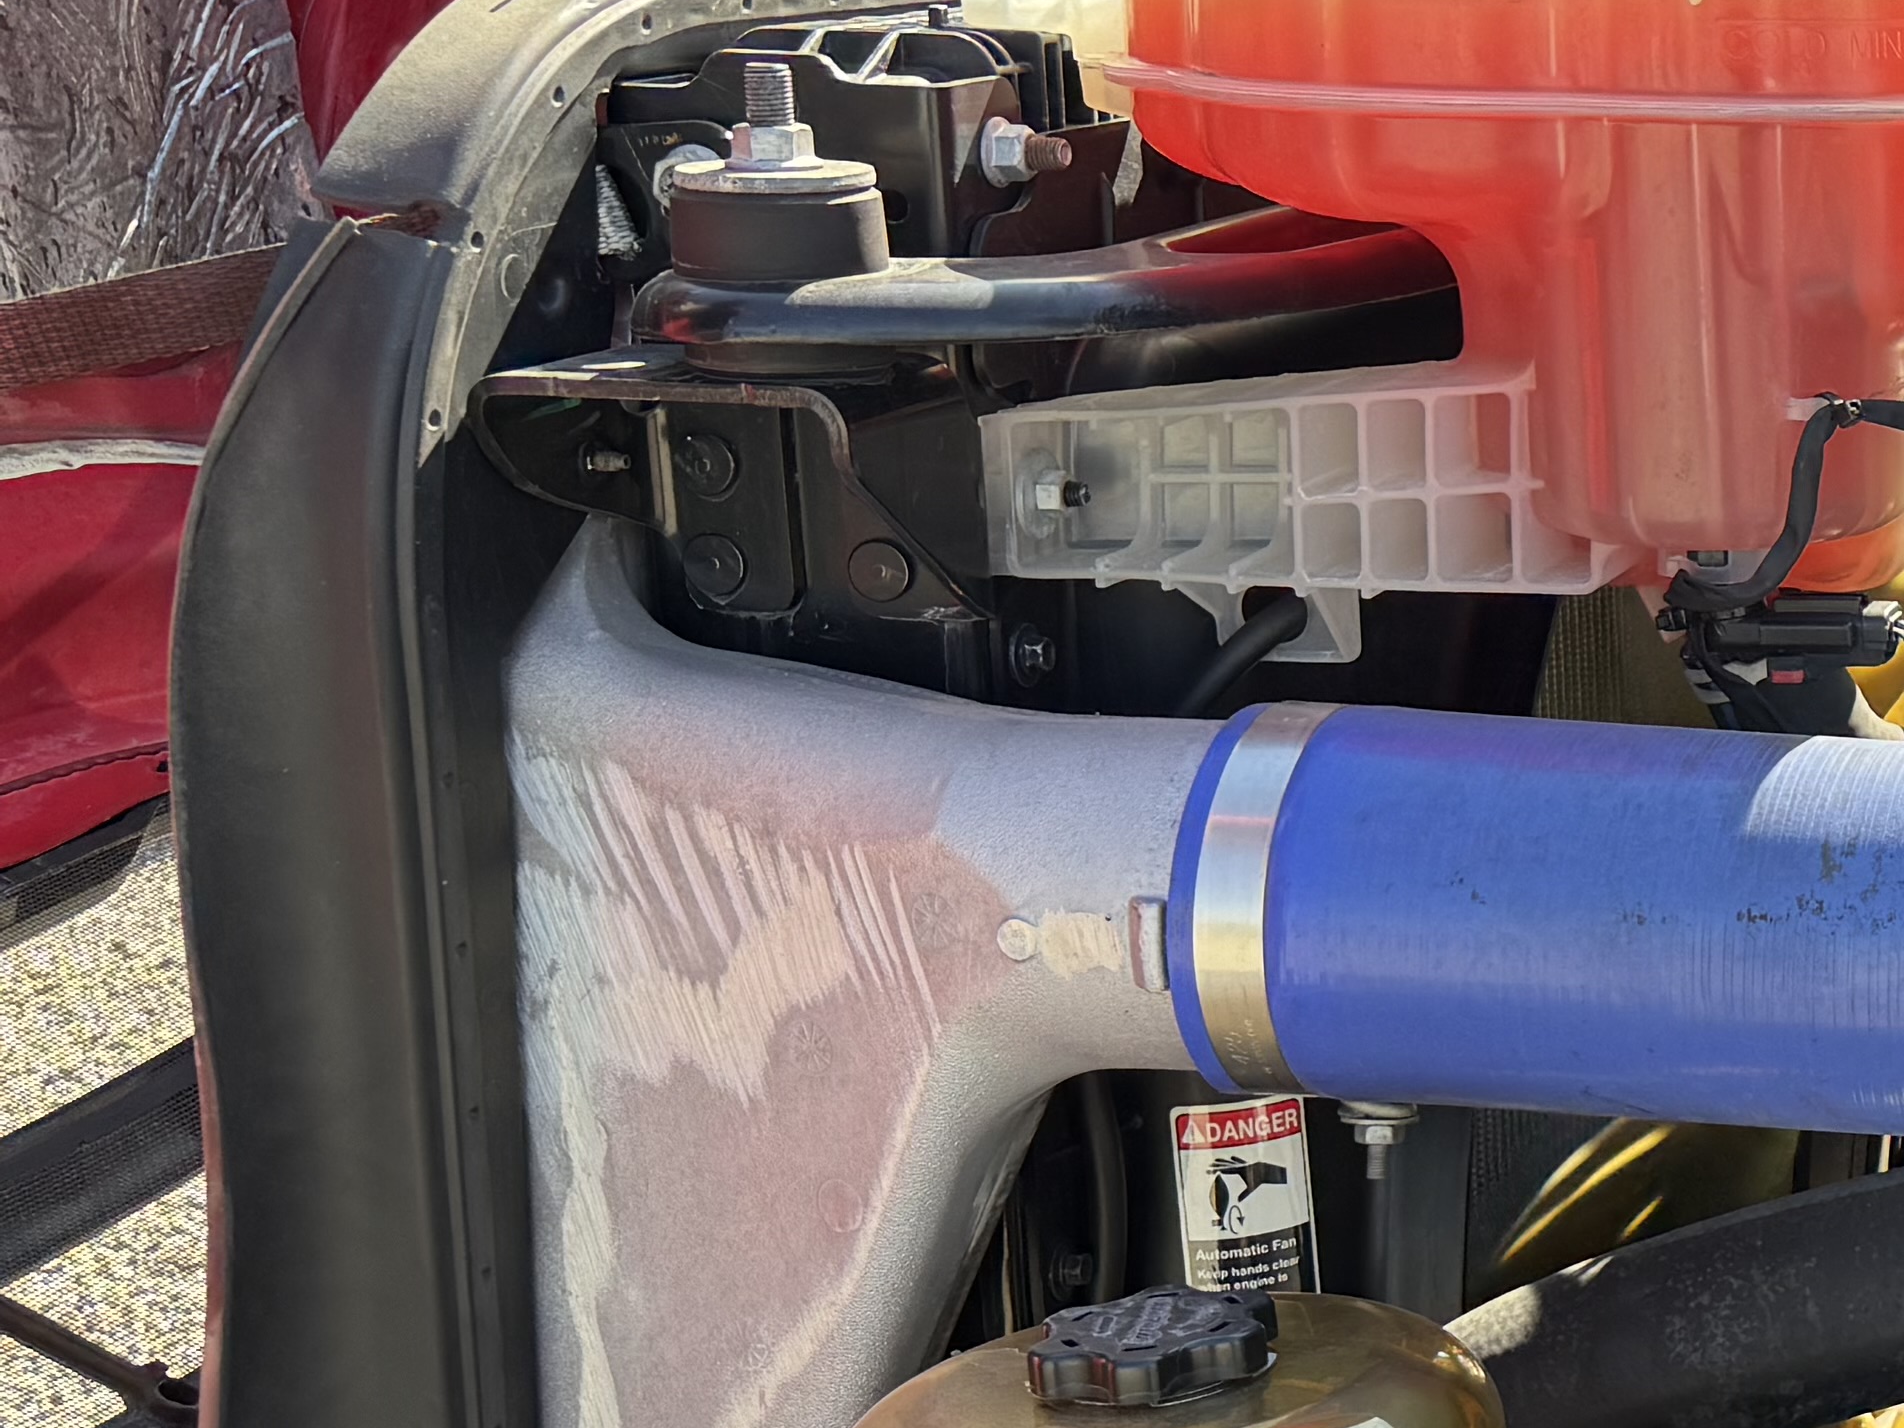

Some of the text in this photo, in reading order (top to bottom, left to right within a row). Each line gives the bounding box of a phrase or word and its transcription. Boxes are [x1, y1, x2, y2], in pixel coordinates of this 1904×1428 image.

[1206, 1108, 1299, 1143] DANGER
[1195, 1236, 1297, 1261] Automatic Fan
[1198, 1255, 1300, 1279] Keep hands clear
[1234, 1276, 1275, 1291] engine
[1278, 1273, 1289, 1283] is
